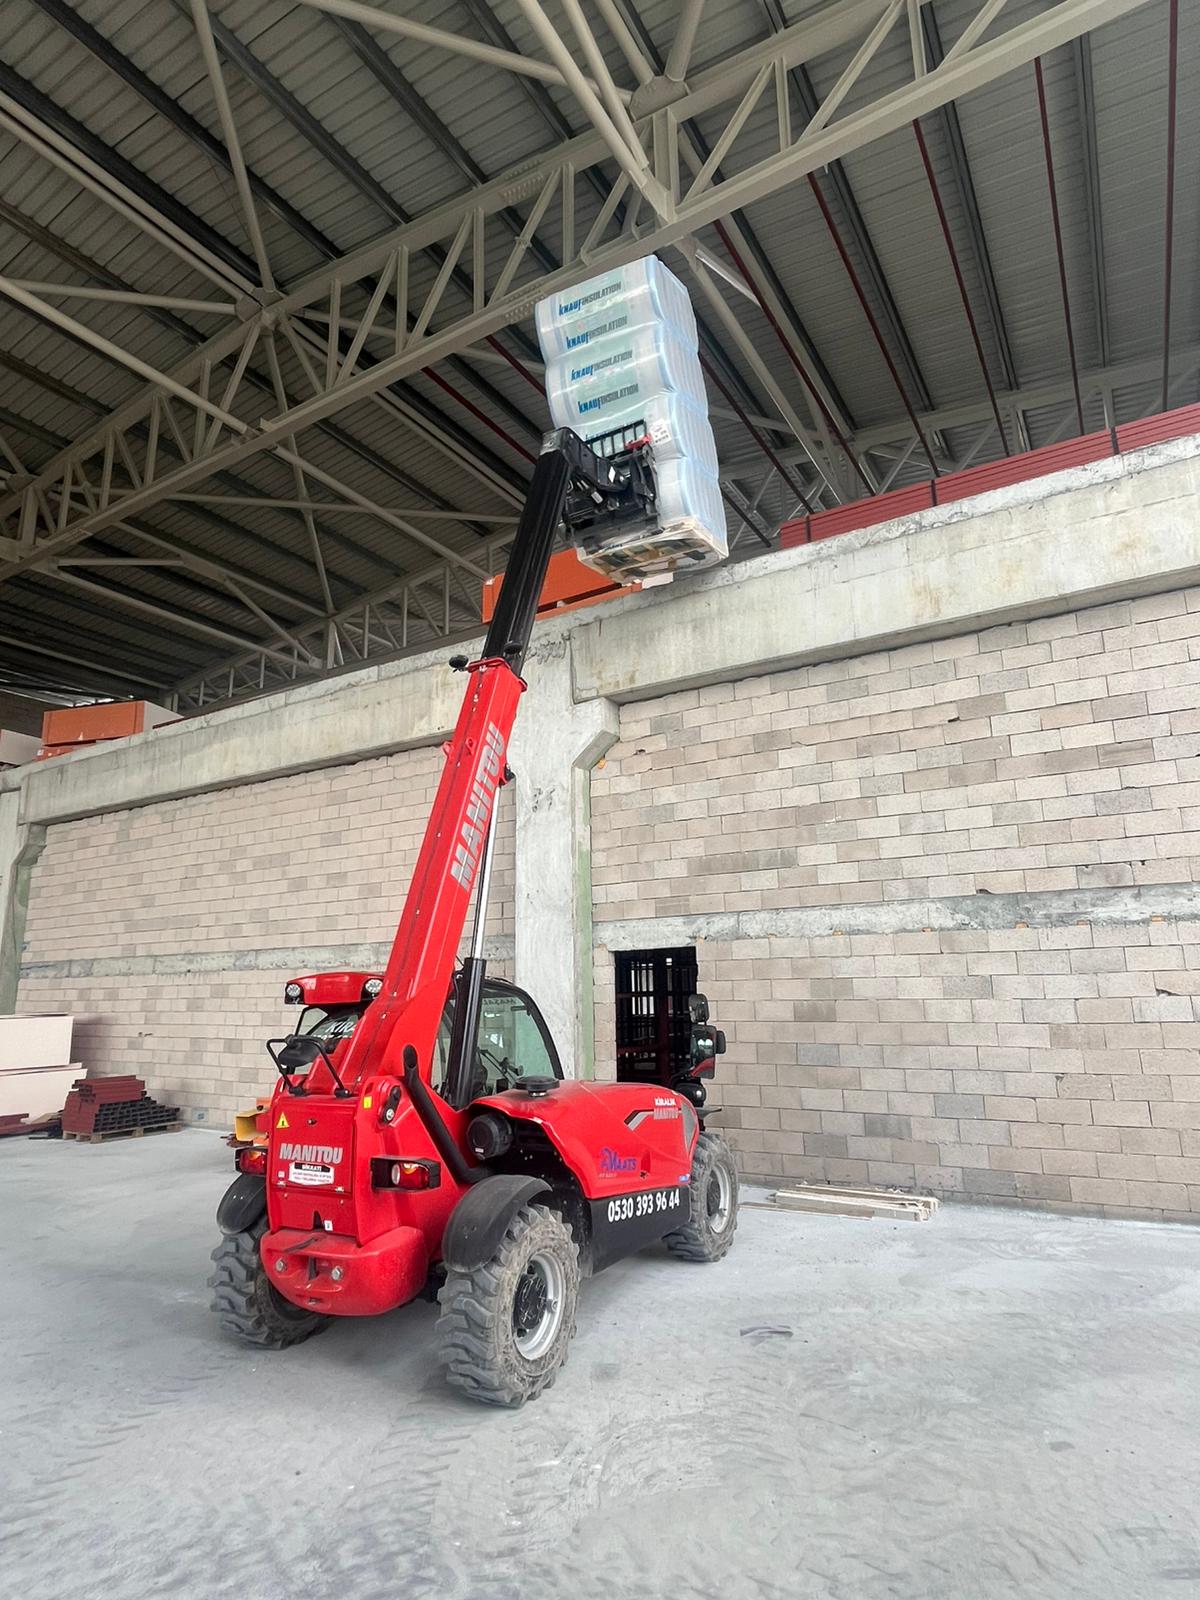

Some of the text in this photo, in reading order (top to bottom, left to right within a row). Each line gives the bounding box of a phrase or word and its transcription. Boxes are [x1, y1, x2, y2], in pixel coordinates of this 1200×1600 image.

[450, 721, 505, 893] MANITOU
[279, 1142, 344, 1164] MANITOU
[607, 1188, 680, 1223] 0530 393 96 44
